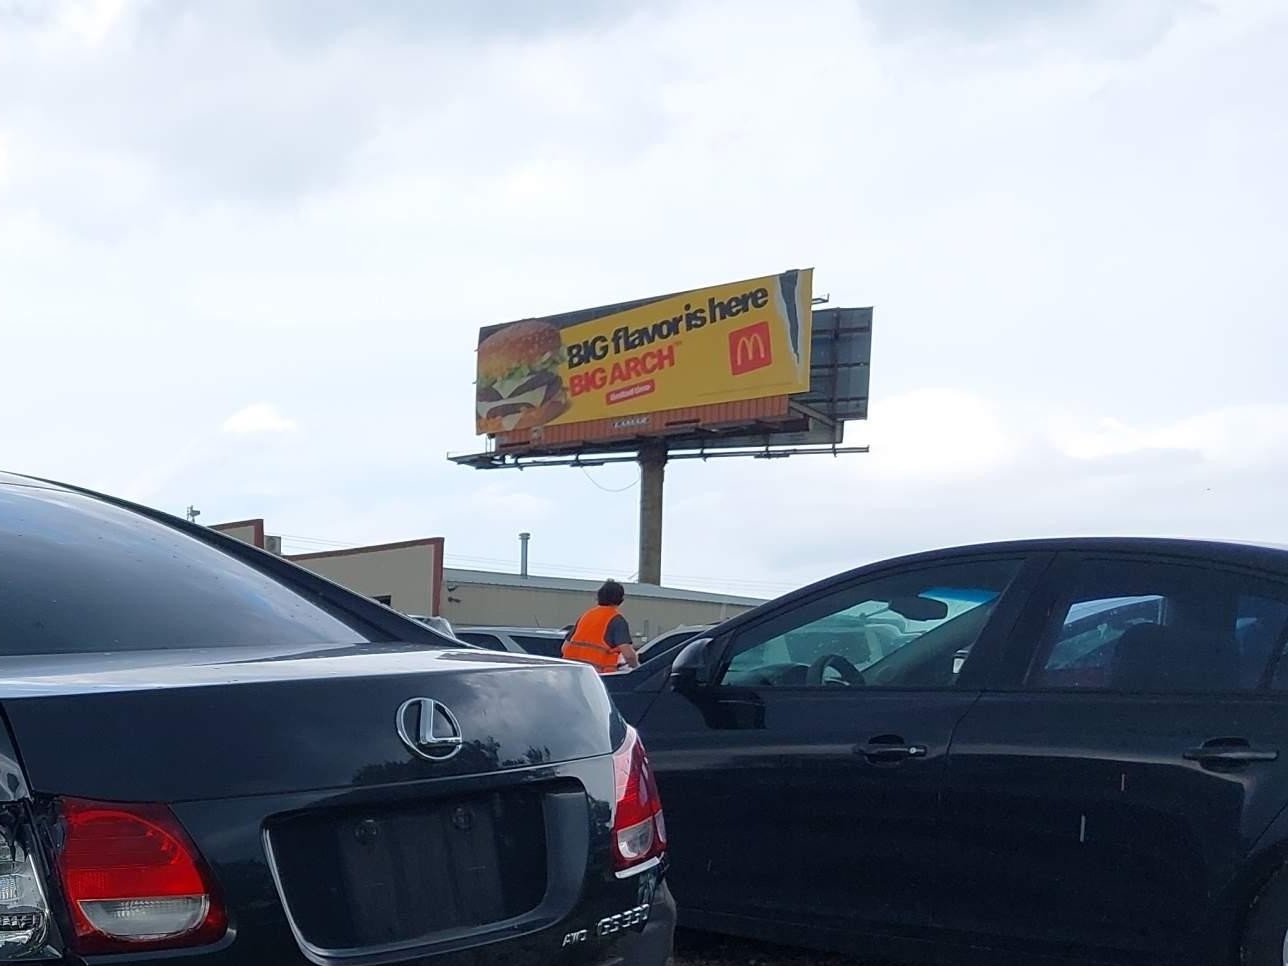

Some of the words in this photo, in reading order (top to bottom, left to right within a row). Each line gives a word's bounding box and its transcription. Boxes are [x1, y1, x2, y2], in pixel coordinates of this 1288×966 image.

[567, 335, 609, 369] BIG
[612, 314, 683, 355] flavor
[685, 303, 707, 332] is
[708, 287, 769, 324] here
[569, 367, 608, 397] BIG
[609, 345, 675, 385] ARCH
